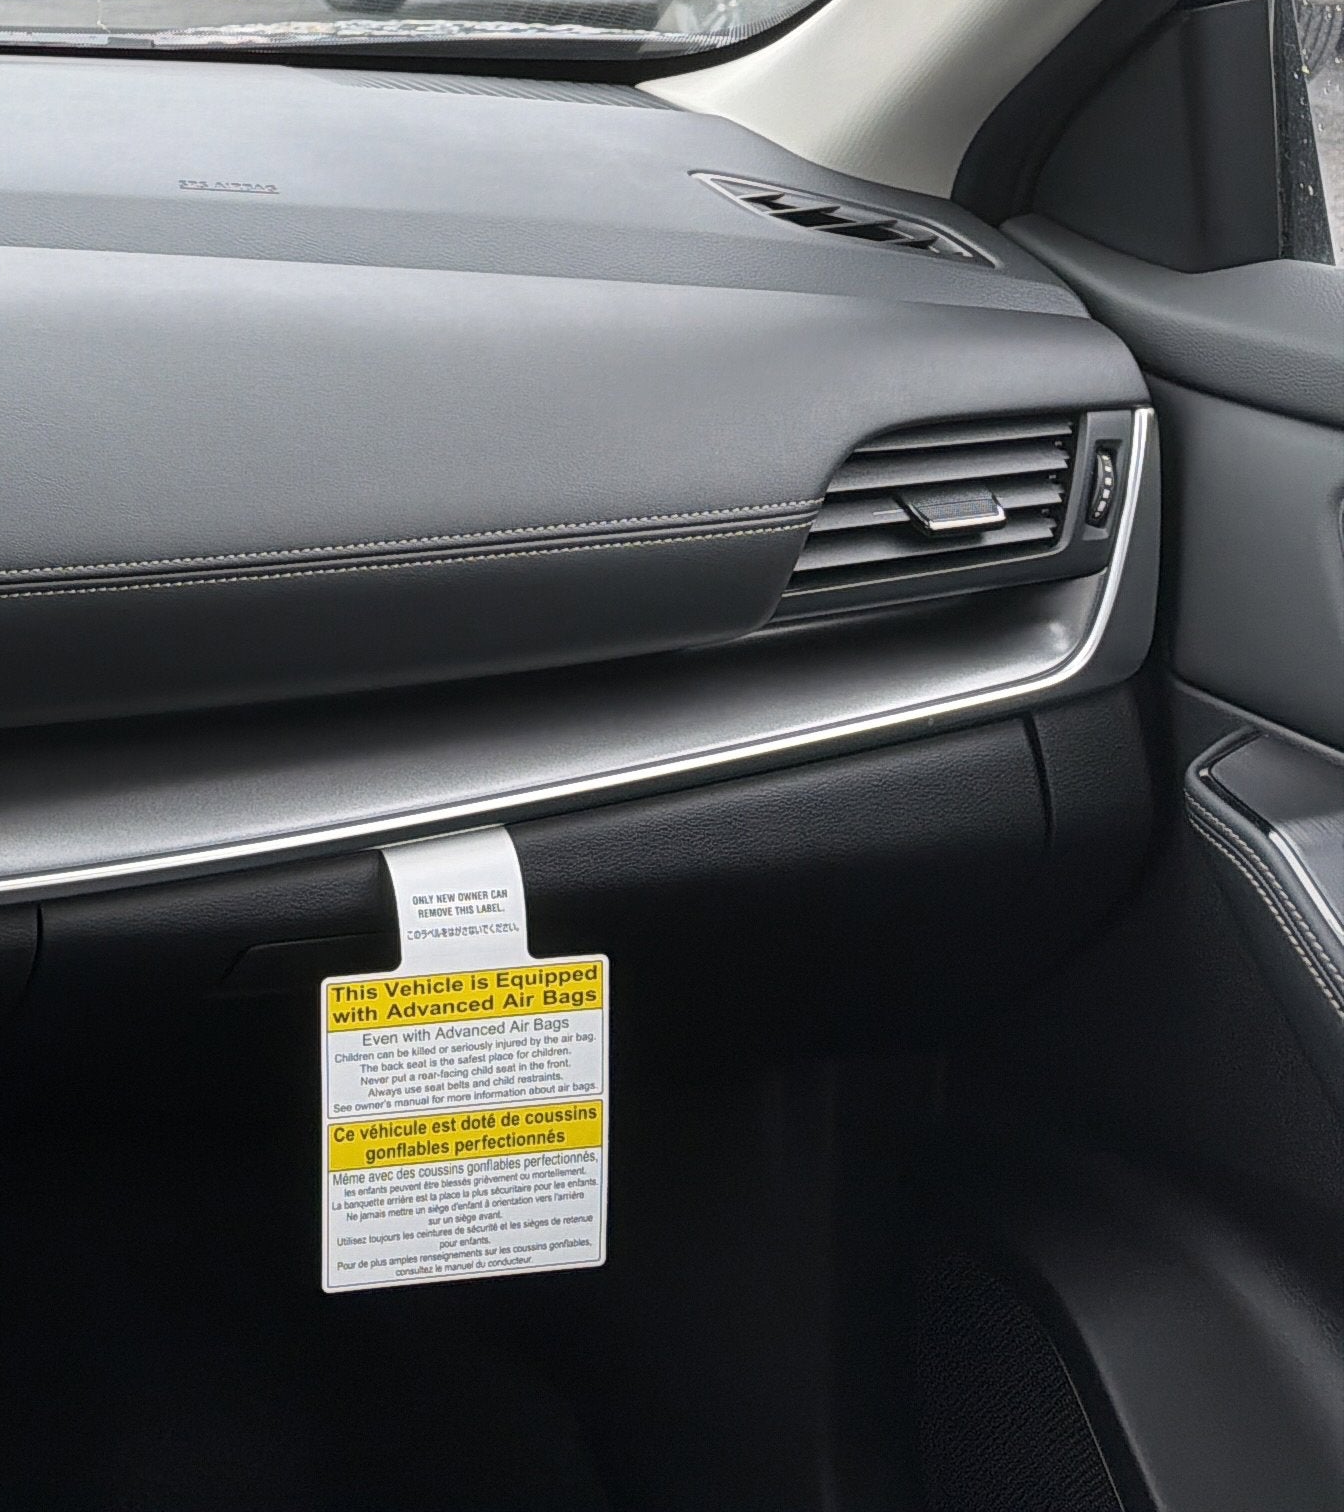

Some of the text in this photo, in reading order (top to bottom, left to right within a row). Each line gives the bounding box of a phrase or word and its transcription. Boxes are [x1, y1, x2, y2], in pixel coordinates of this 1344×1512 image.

[412, 889, 507, 905] ONLY NEW OWNER CAN
[418, 903, 504, 918] REMOVE THIS LABEL.
[332, 965, 597, 1002] This Vehicle is Equipped
[333, 989, 597, 1023] with Advanced Air Bags
[363, 1018, 569, 1046] Even with Advanced Air Bags
[334, 1105, 597, 1143] Ce véhicule est doté de coussins
[366, 1128, 566, 1164] gonflables perfectionnés
[368, 1171, 394, 1182] avec
[396, 1168, 416, 1180] des
[419, 1163, 464, 1178] coussins
[467, 1158, 521, 1176] gonflables
[523, 1150, 599, 1169] perfectionnés,
